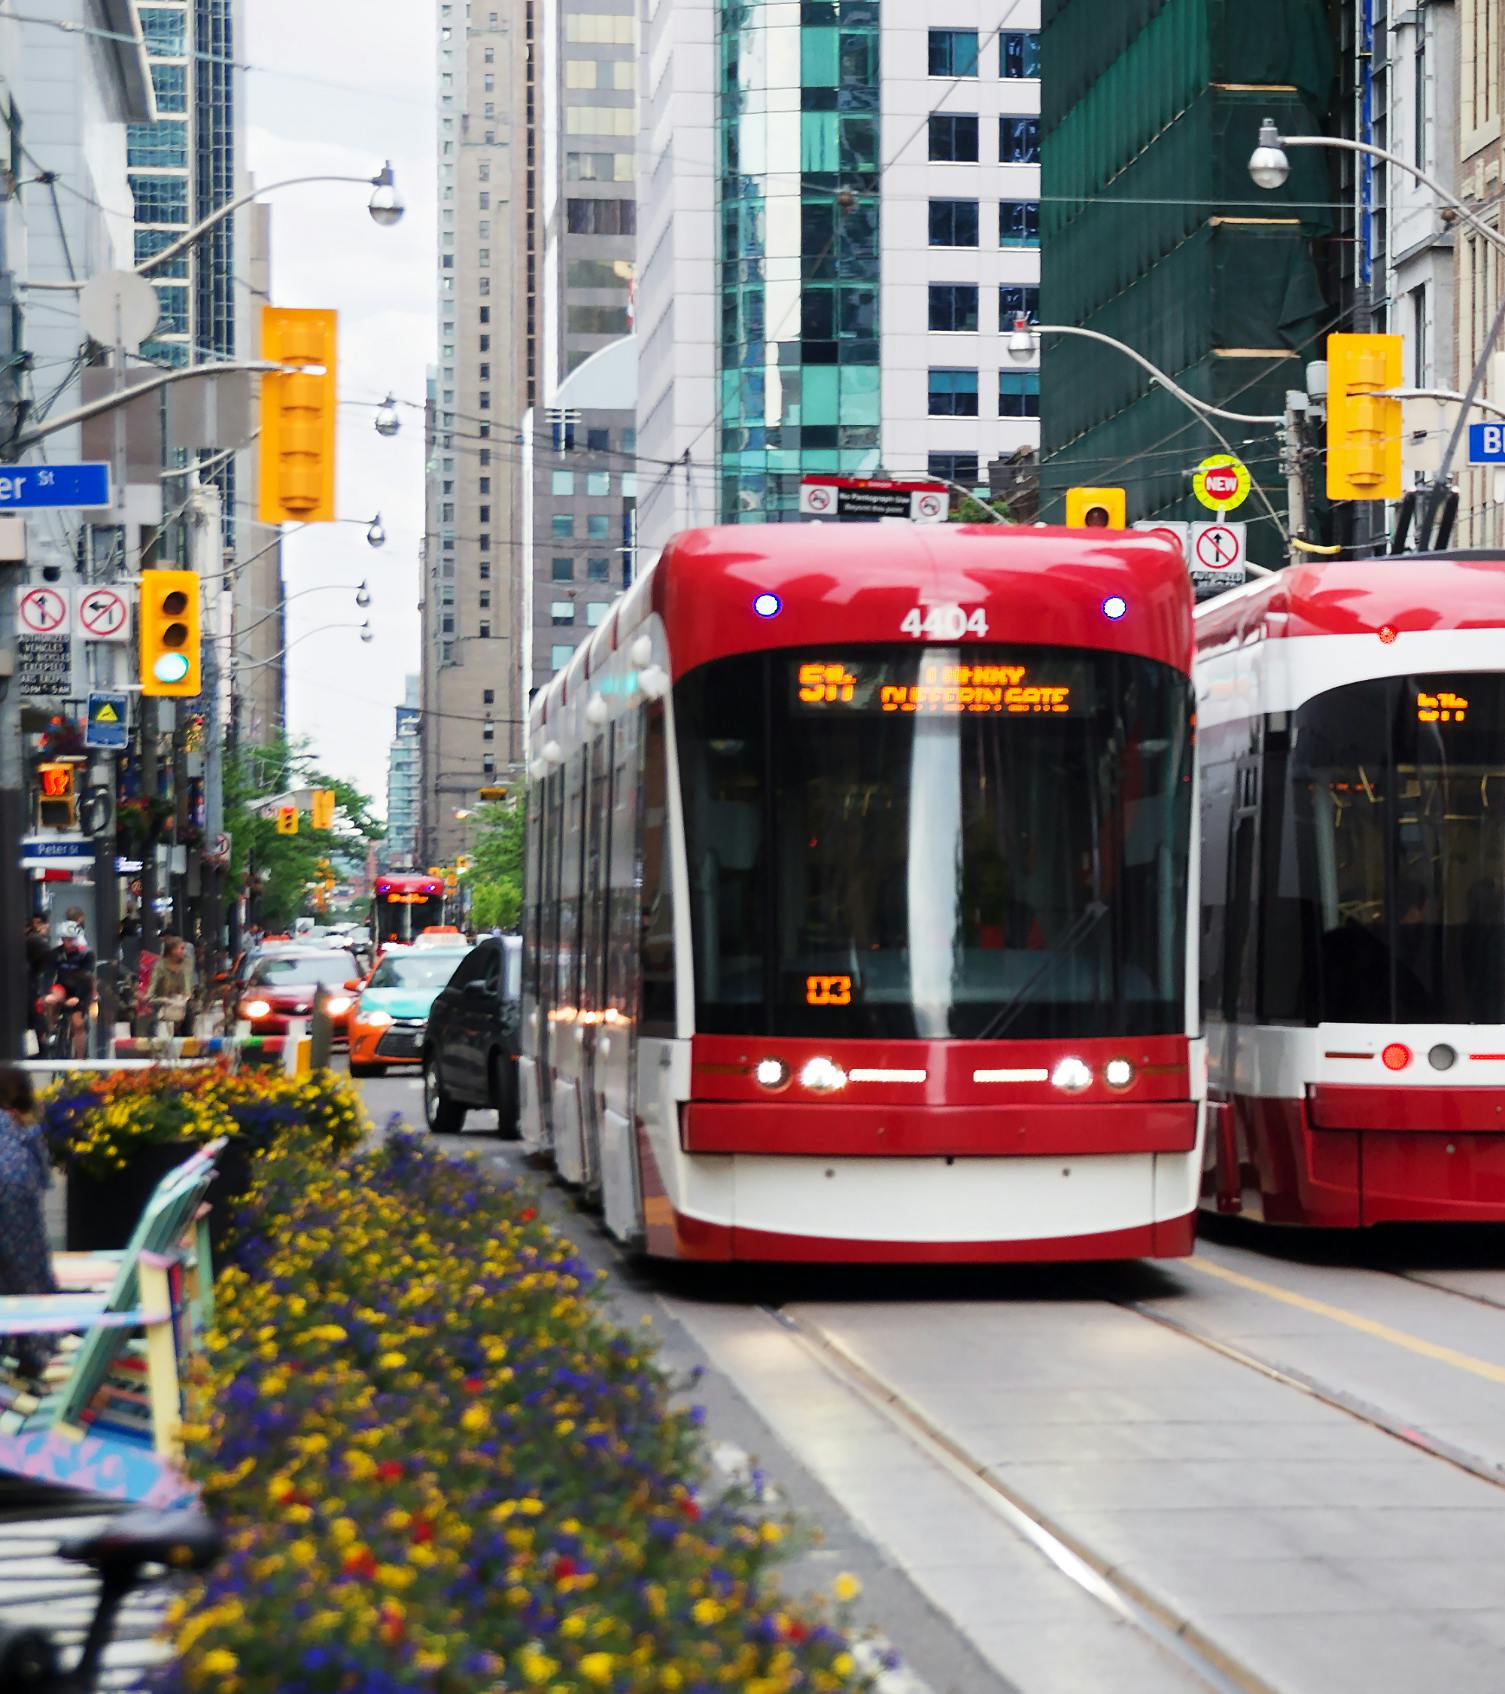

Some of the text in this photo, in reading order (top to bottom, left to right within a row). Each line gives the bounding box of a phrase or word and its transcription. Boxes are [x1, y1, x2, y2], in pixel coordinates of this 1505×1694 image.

[37, 470, 55, 486] St
[1206, 476, 1237, 492] NEW
[900, 607, 989, 640] 4404
[38, 844, 67, 855] Peter
